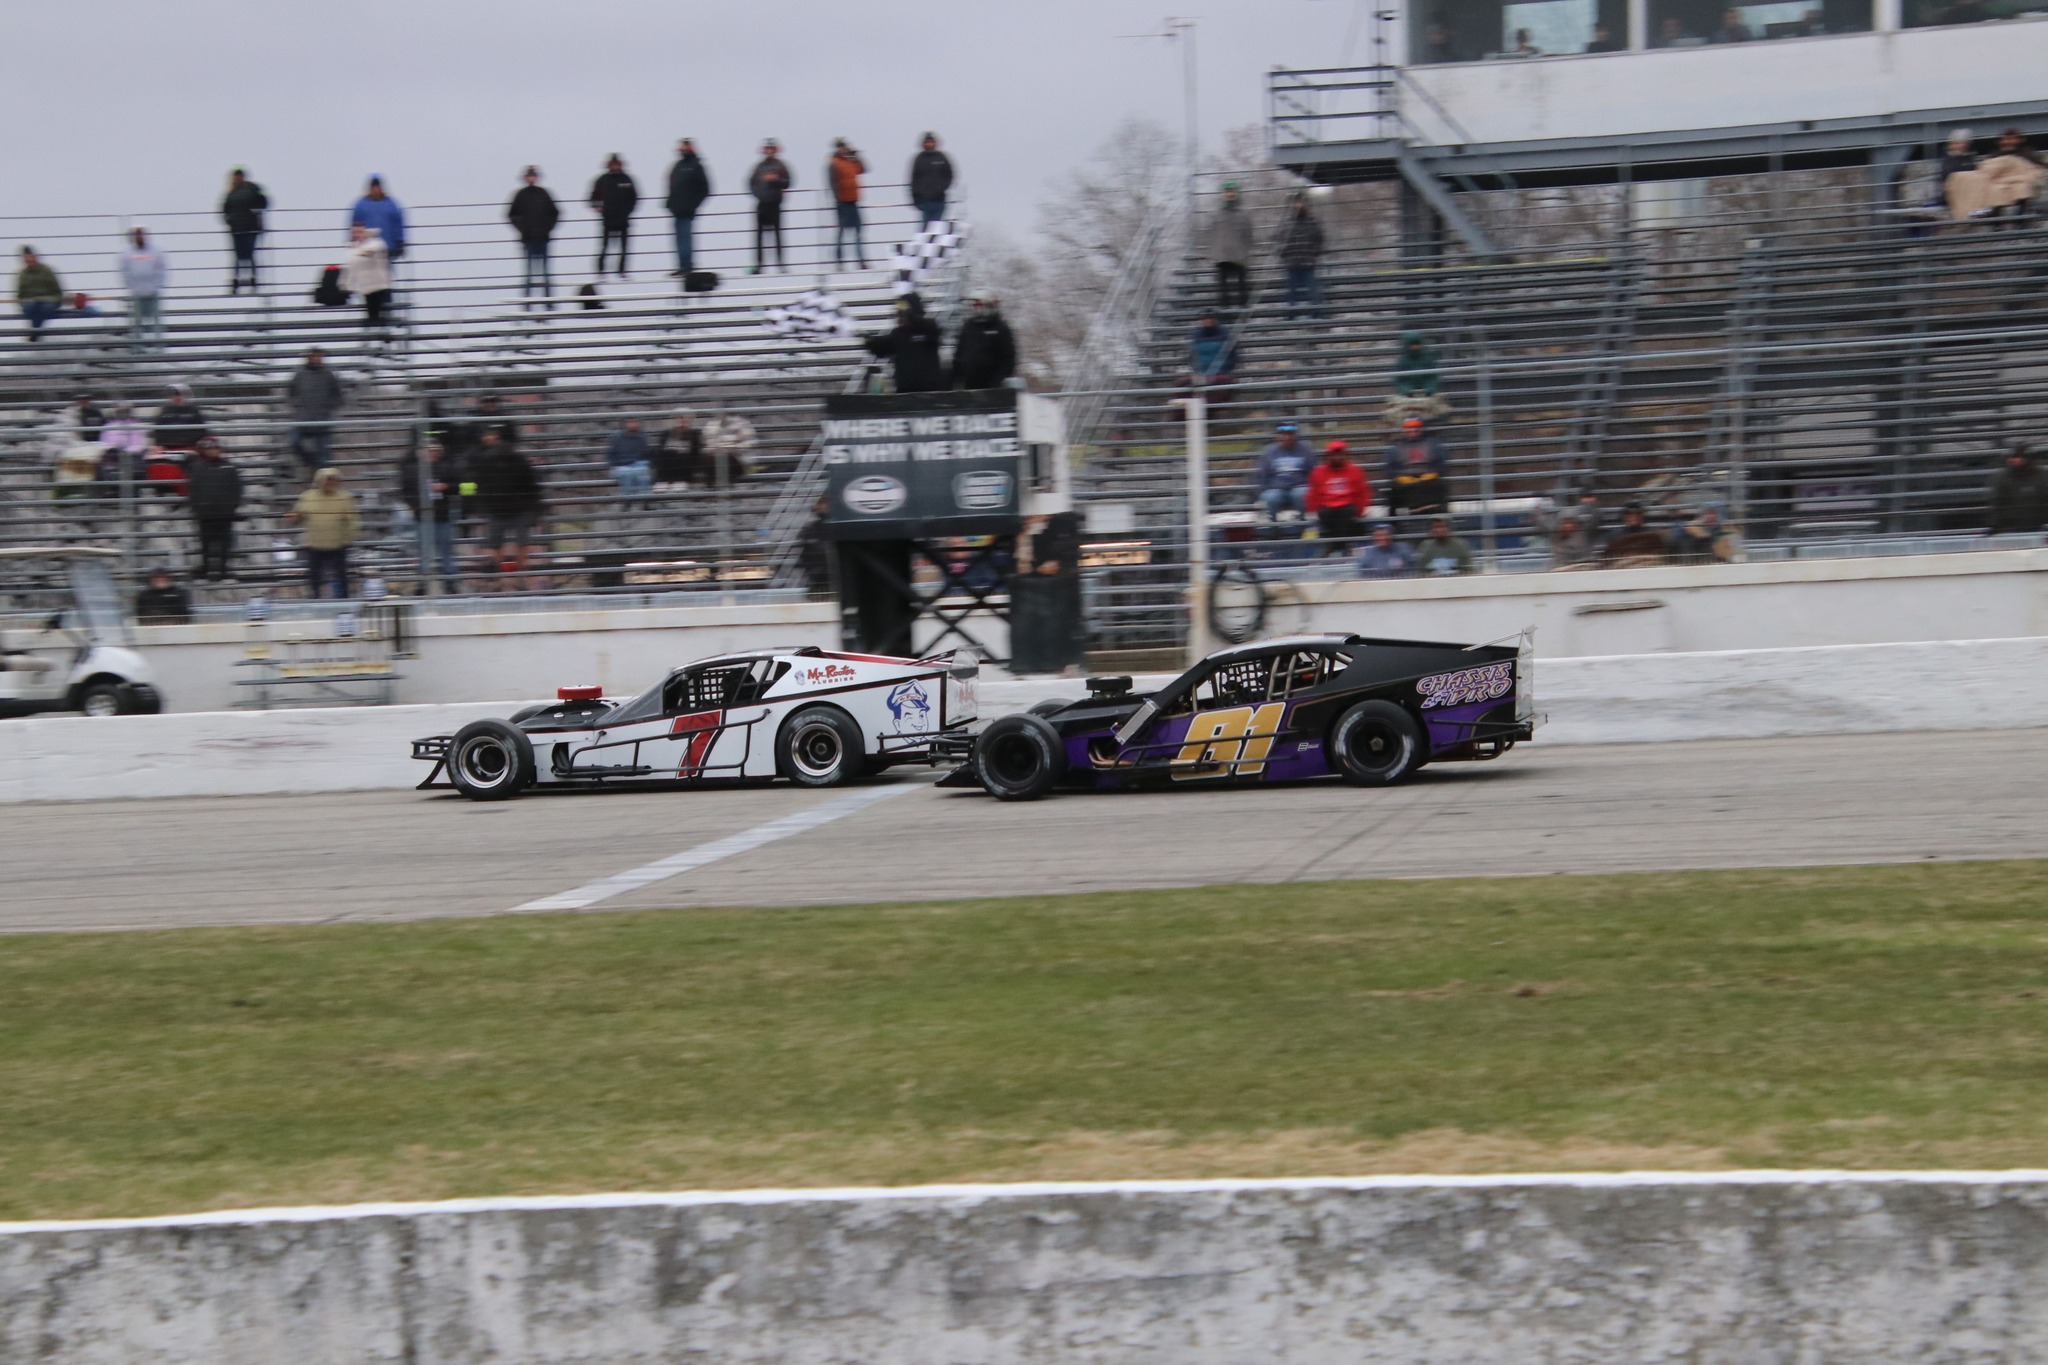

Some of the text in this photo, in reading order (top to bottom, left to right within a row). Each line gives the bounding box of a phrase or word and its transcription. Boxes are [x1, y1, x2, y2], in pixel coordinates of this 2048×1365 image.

[821, 412, 1017, 438] WHERE WE RACE
[911, 440, 951, 461] WE
[952, 437, 1019, 458] RACE
[807, 667, 826, 680] Mr.
[1416, 662, 1512, 695] CHASSIS
[1447, 678, 1512, 706] PRO
[669, 708, 724, 780] 7
